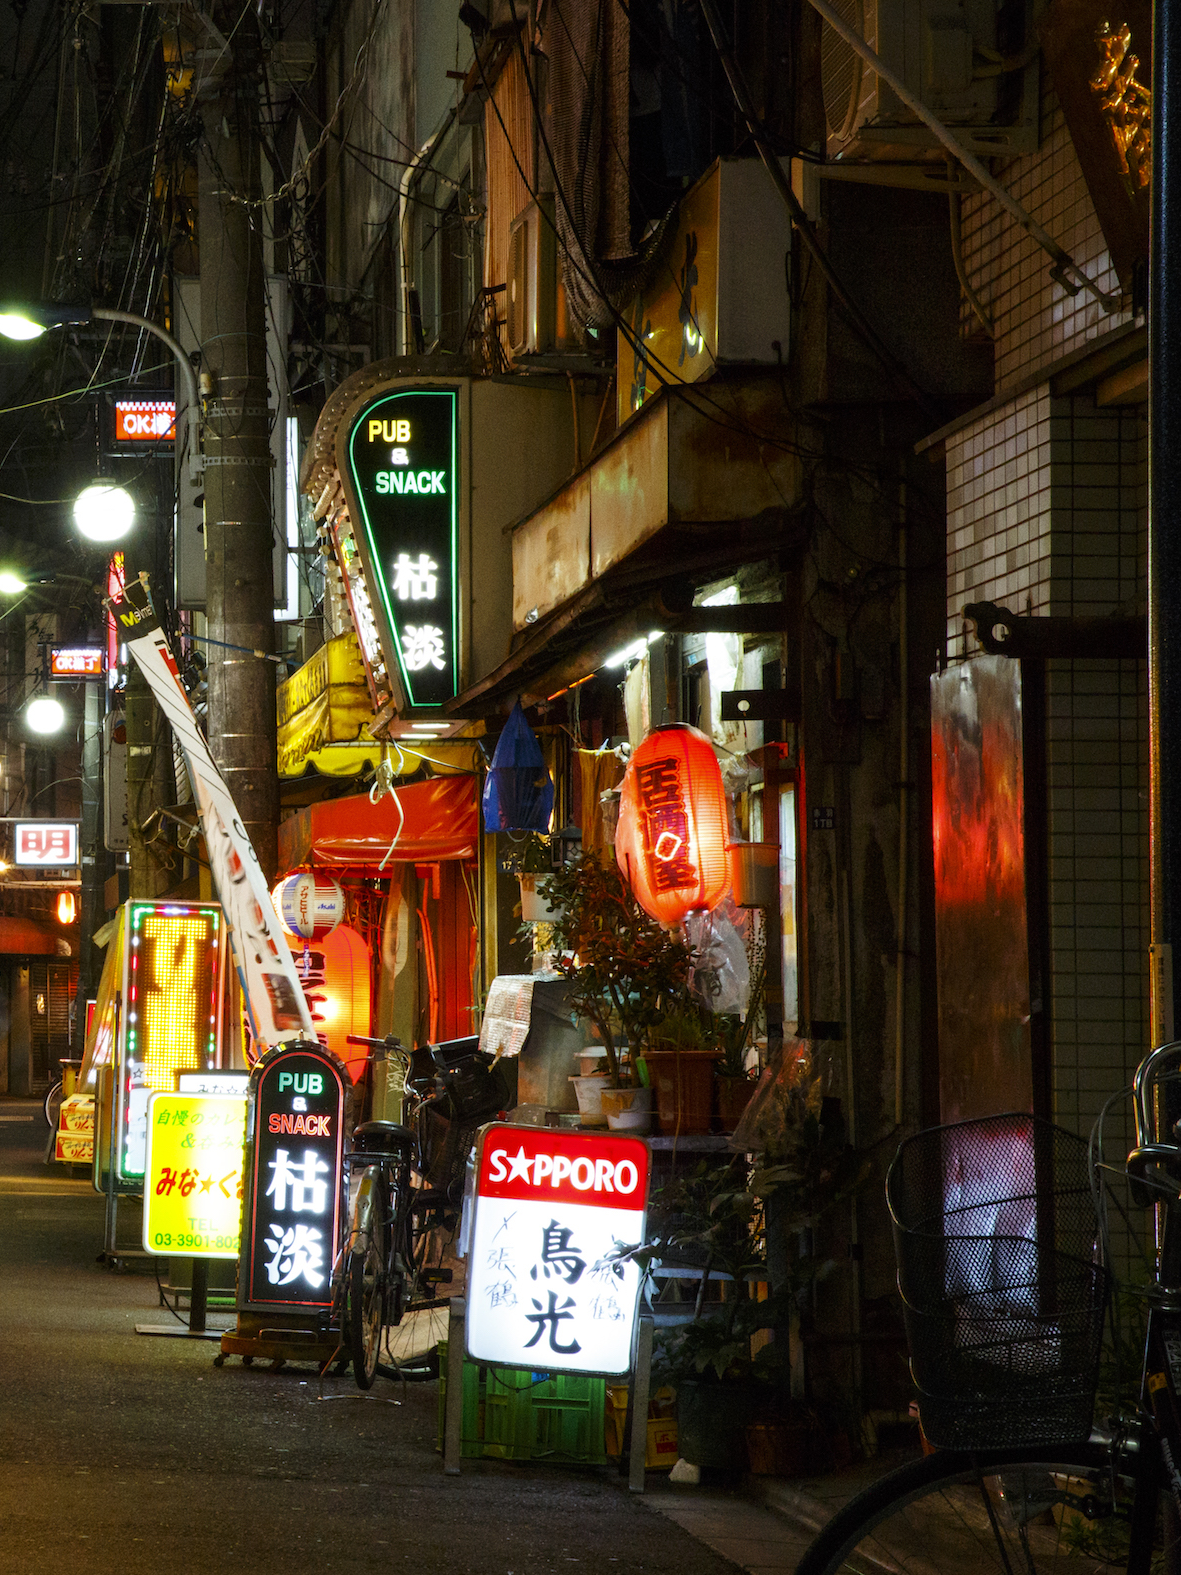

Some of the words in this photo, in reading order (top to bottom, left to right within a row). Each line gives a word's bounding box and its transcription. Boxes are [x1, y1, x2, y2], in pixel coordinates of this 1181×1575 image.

[123, 413, 175, 435] OK横
[369, 419, 411, 443] PUB
[391, 448, 409, 465] &
[375, 470, 446, 495] SNACK
[393, 553, 447, 671] 枯淡
[22, 830, 70, 858] 明
[318, 903, 336, 911] Asahi
[278, 1072, 323, 1095] PUB
[292, 1097, 307, 1111] &
[269, 1113, 331, 1137] SNACK
[187, 1217, 219, 1231] TEL
[264, 1148, 330, 1289] 枯淡
[523, 1218, 588, 1355] 鳥光
